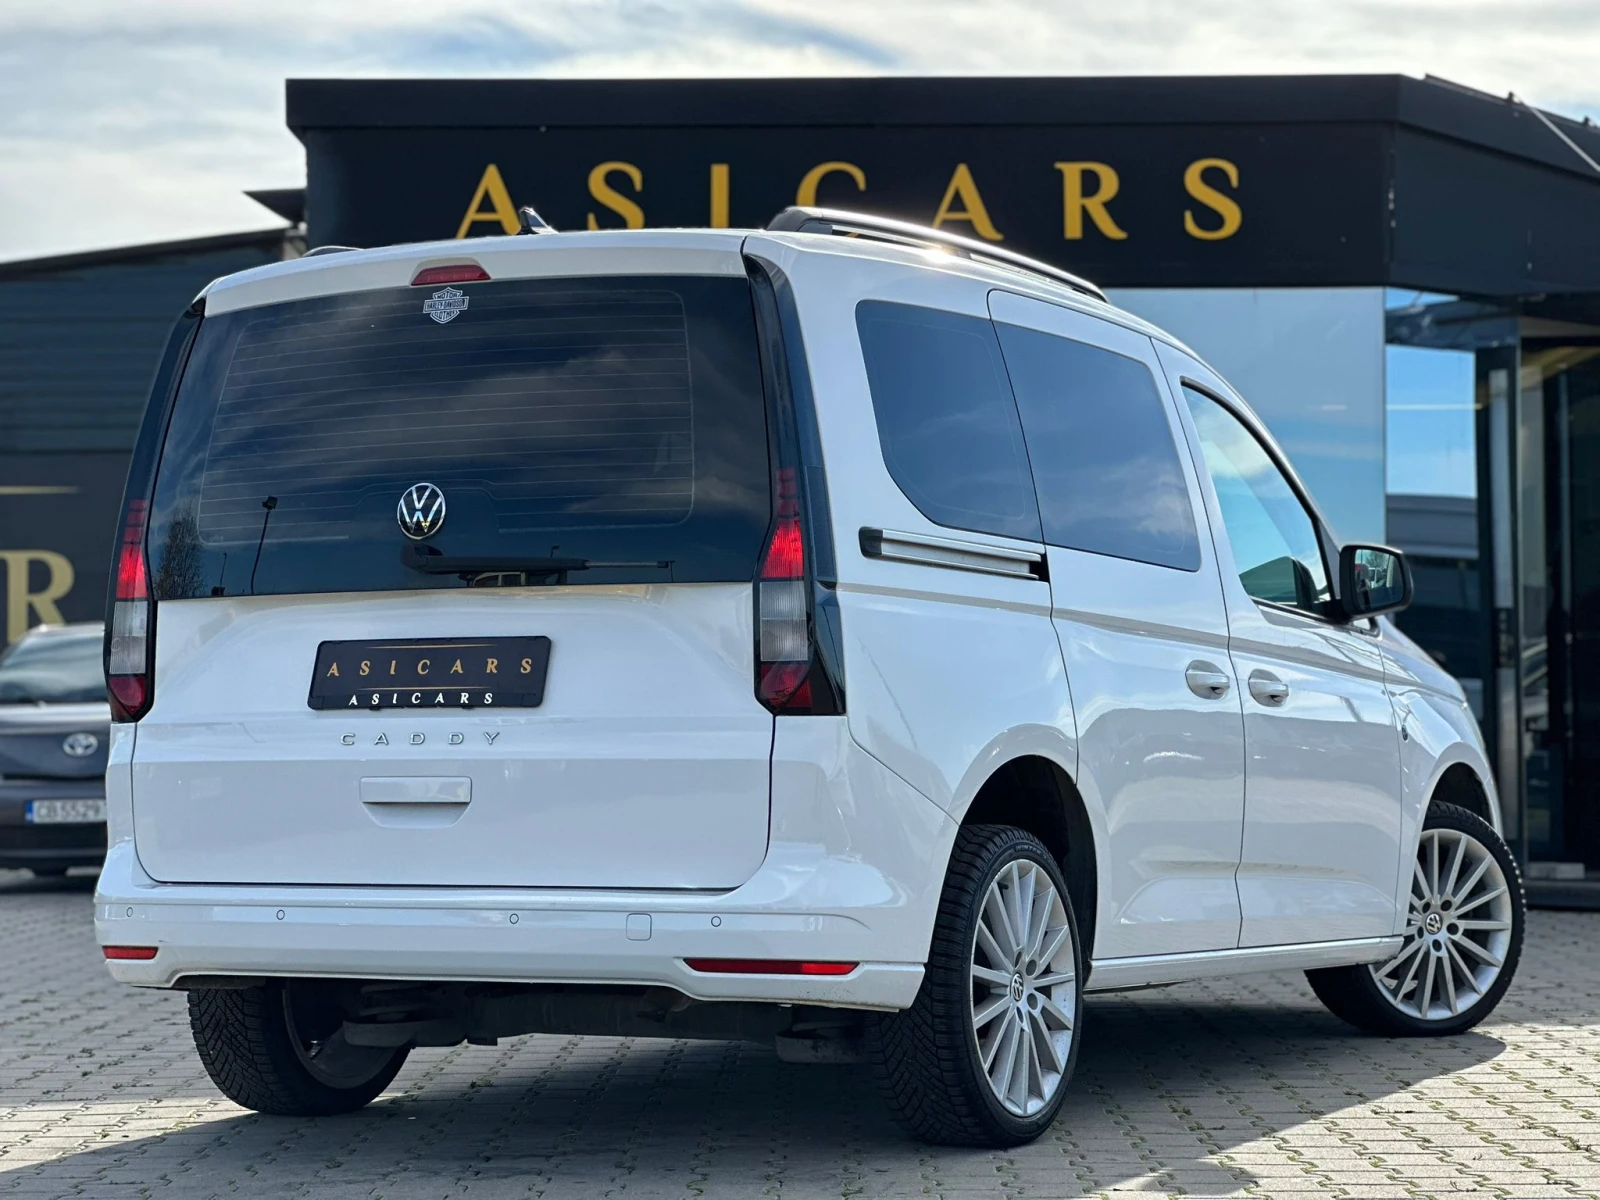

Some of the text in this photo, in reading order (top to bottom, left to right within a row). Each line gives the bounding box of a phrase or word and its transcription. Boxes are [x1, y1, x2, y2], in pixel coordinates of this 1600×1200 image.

[456, 158, 1242, 241] ASICARS
[437, 291, 459, 299] MOTOR
[327, 658, 533, 677] ASICARS
[348, 692, 493, 706] ASICARS
[340, 732, 500, 746] CADDY
